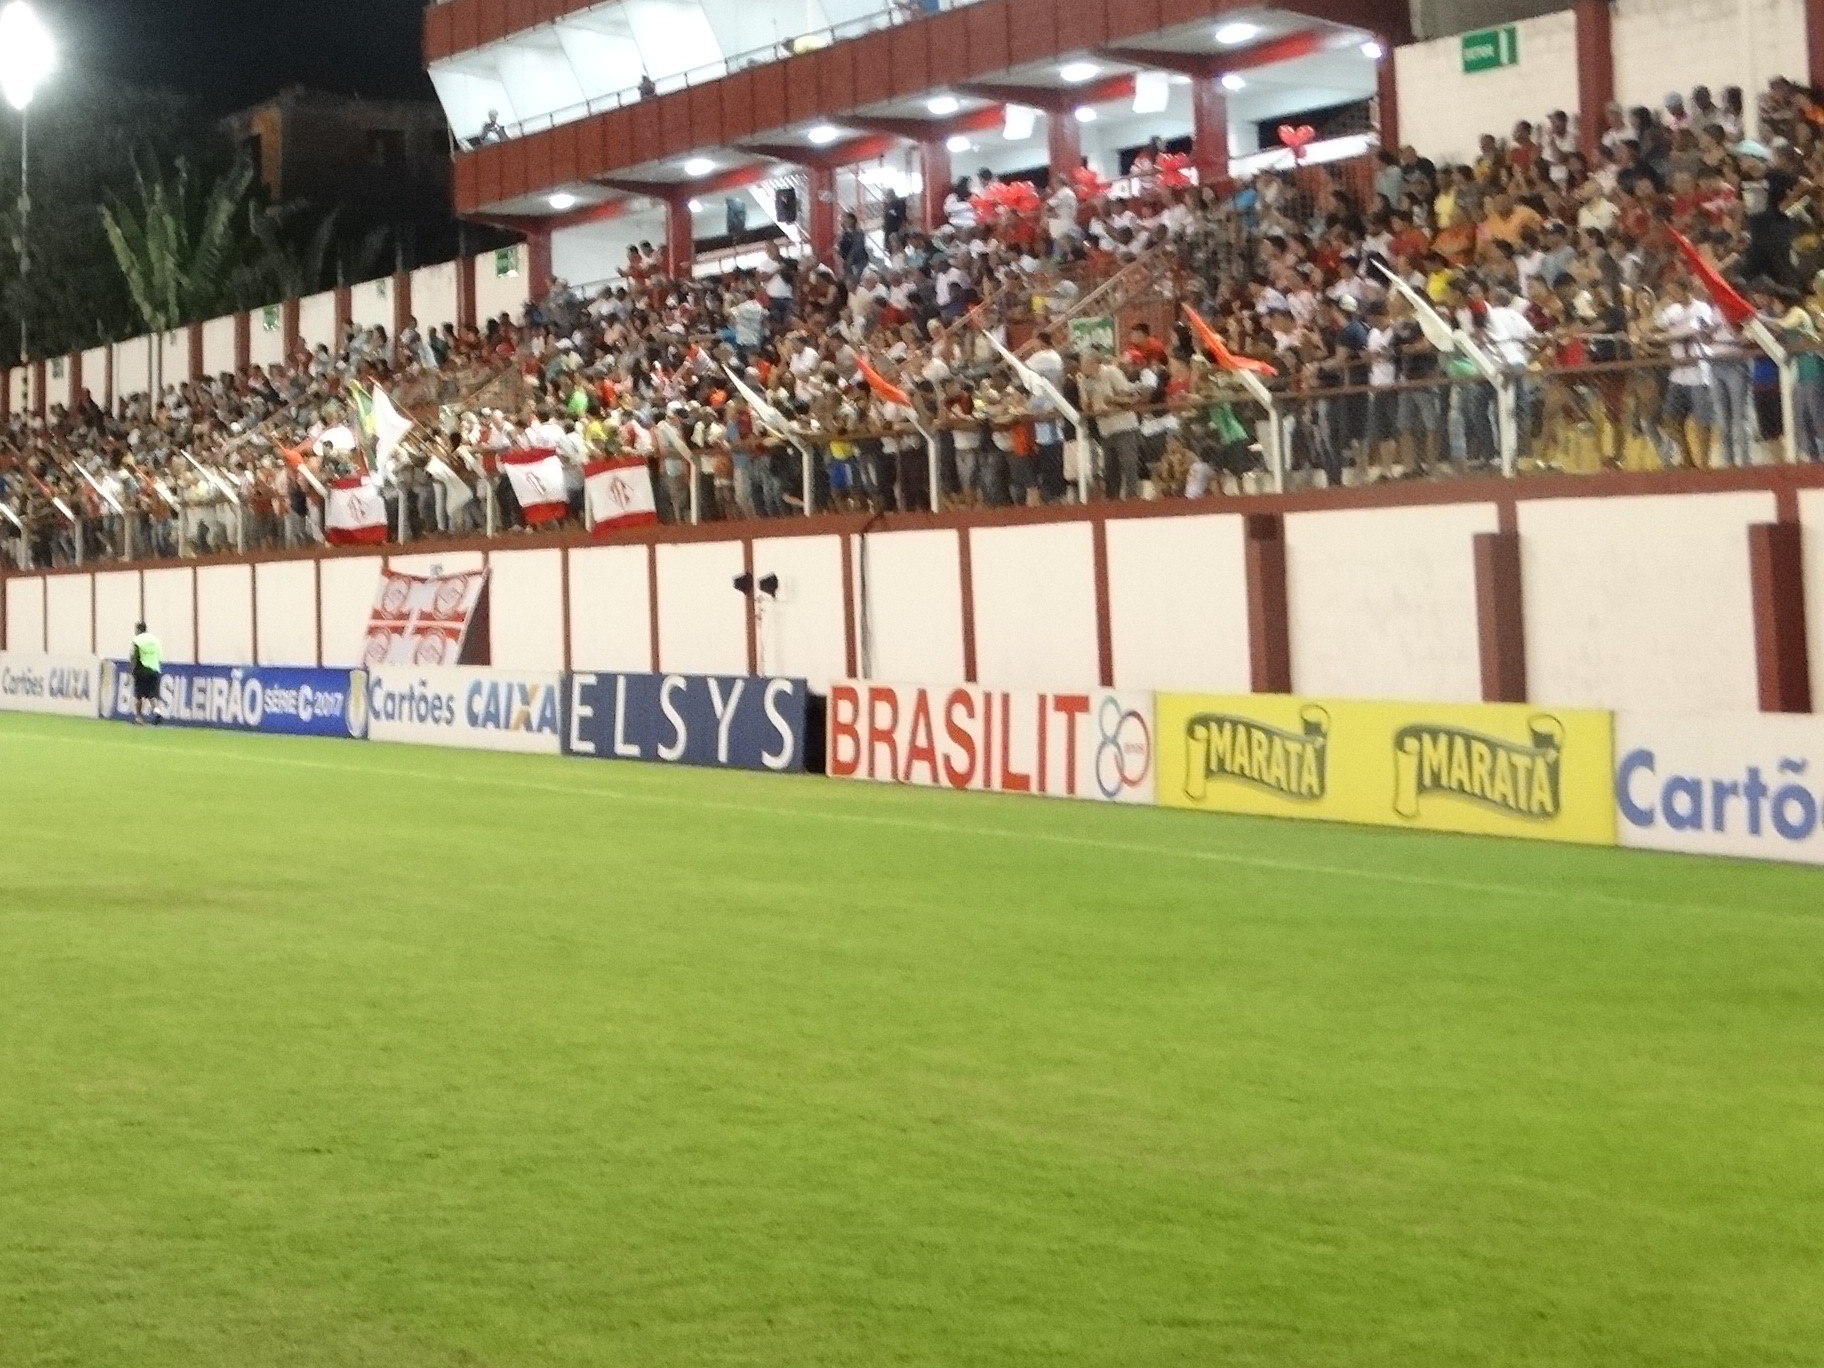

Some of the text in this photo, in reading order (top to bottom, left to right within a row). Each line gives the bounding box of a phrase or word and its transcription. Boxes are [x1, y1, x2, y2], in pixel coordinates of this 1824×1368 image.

[48, 666, 90, 700] CAIXA
[117, 667, 264, 727] BSILEIRÃO
[298, 684, 314, 723] C
[369, 677, 559, 734] Cartões CAIXA
[569, 672, 795, 771] ELSYS
[831, 685, 1089, 797] BRASILIT
[1208, 719, 1326, 797] MARATÁ
[1420, 731, 1562, 815] MARATÁ
[1617, 748, 1824, 841] Cartõ
